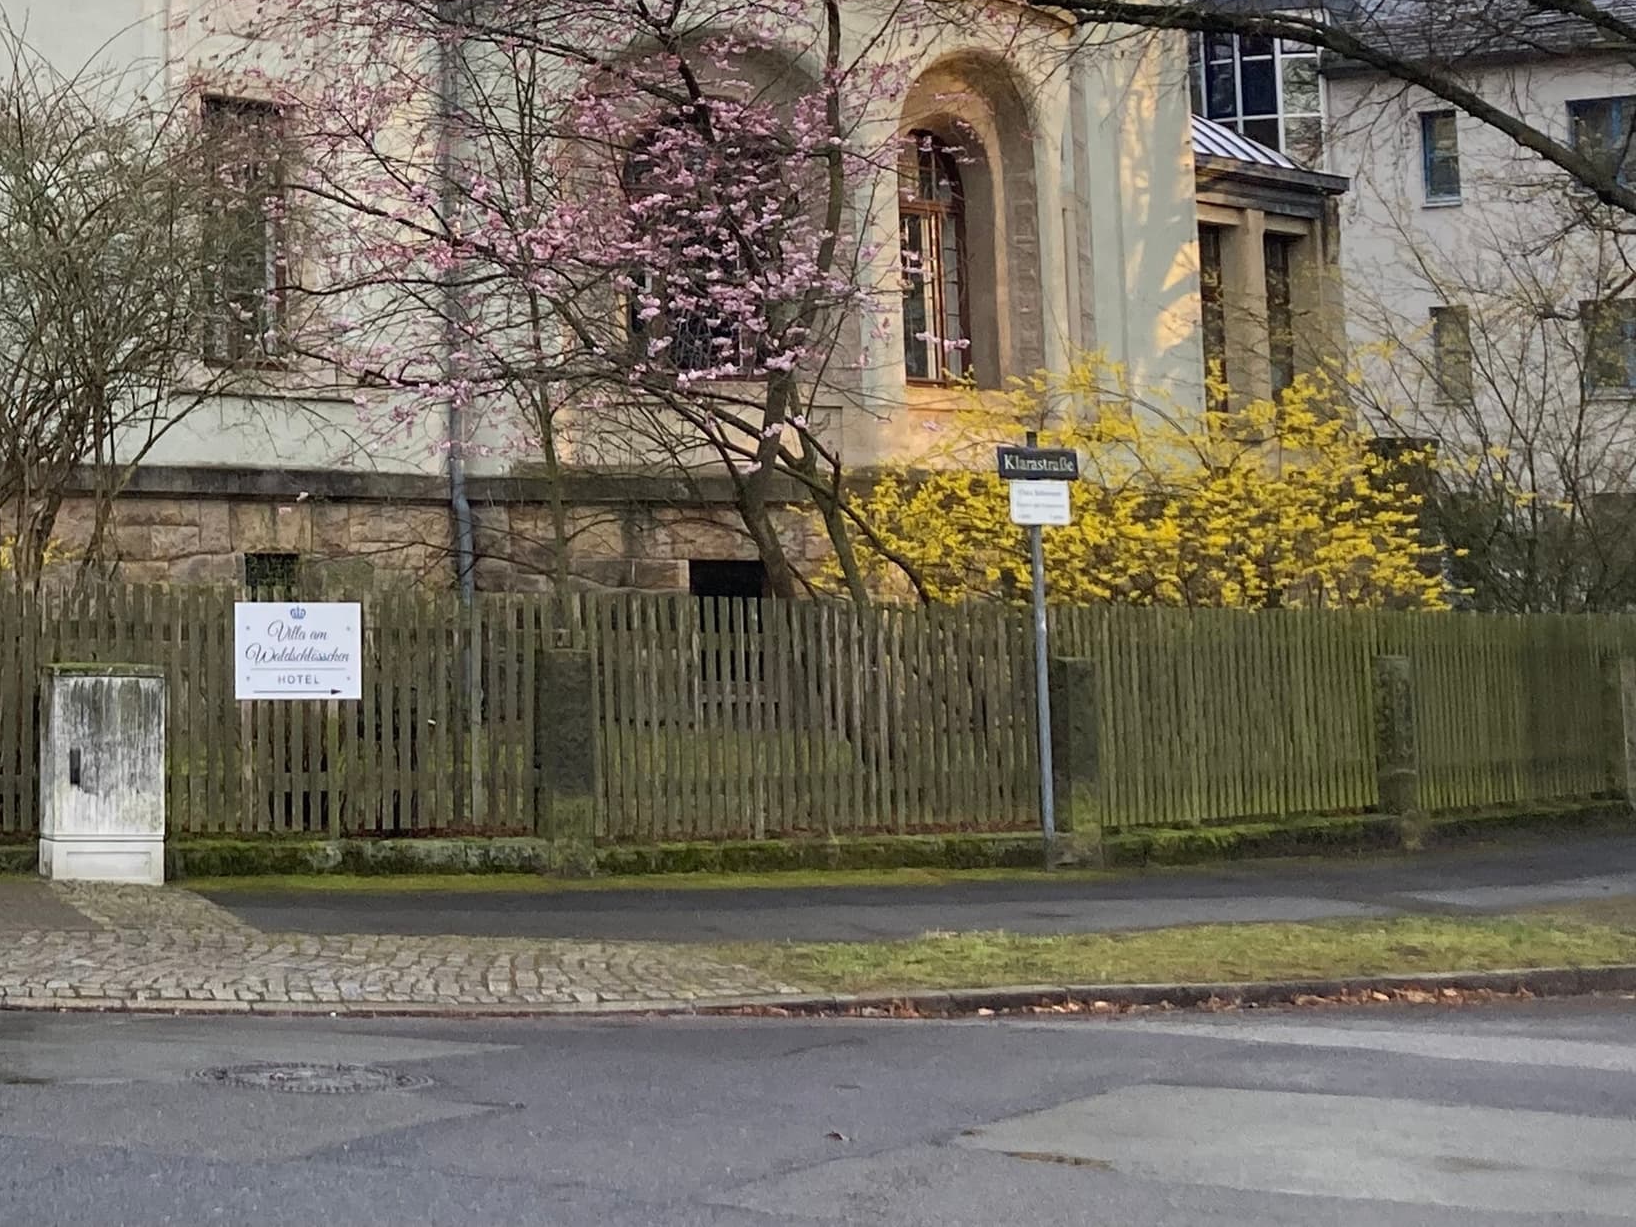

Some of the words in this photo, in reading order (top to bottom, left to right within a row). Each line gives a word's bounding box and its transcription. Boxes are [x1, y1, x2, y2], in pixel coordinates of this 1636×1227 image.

[1004, 454, 1074, 471] Klarastraße
[267, 619, 306, 643] Villa
[309, 631, 328, 641] am
[277, 674, 321, 685] HOTEL
